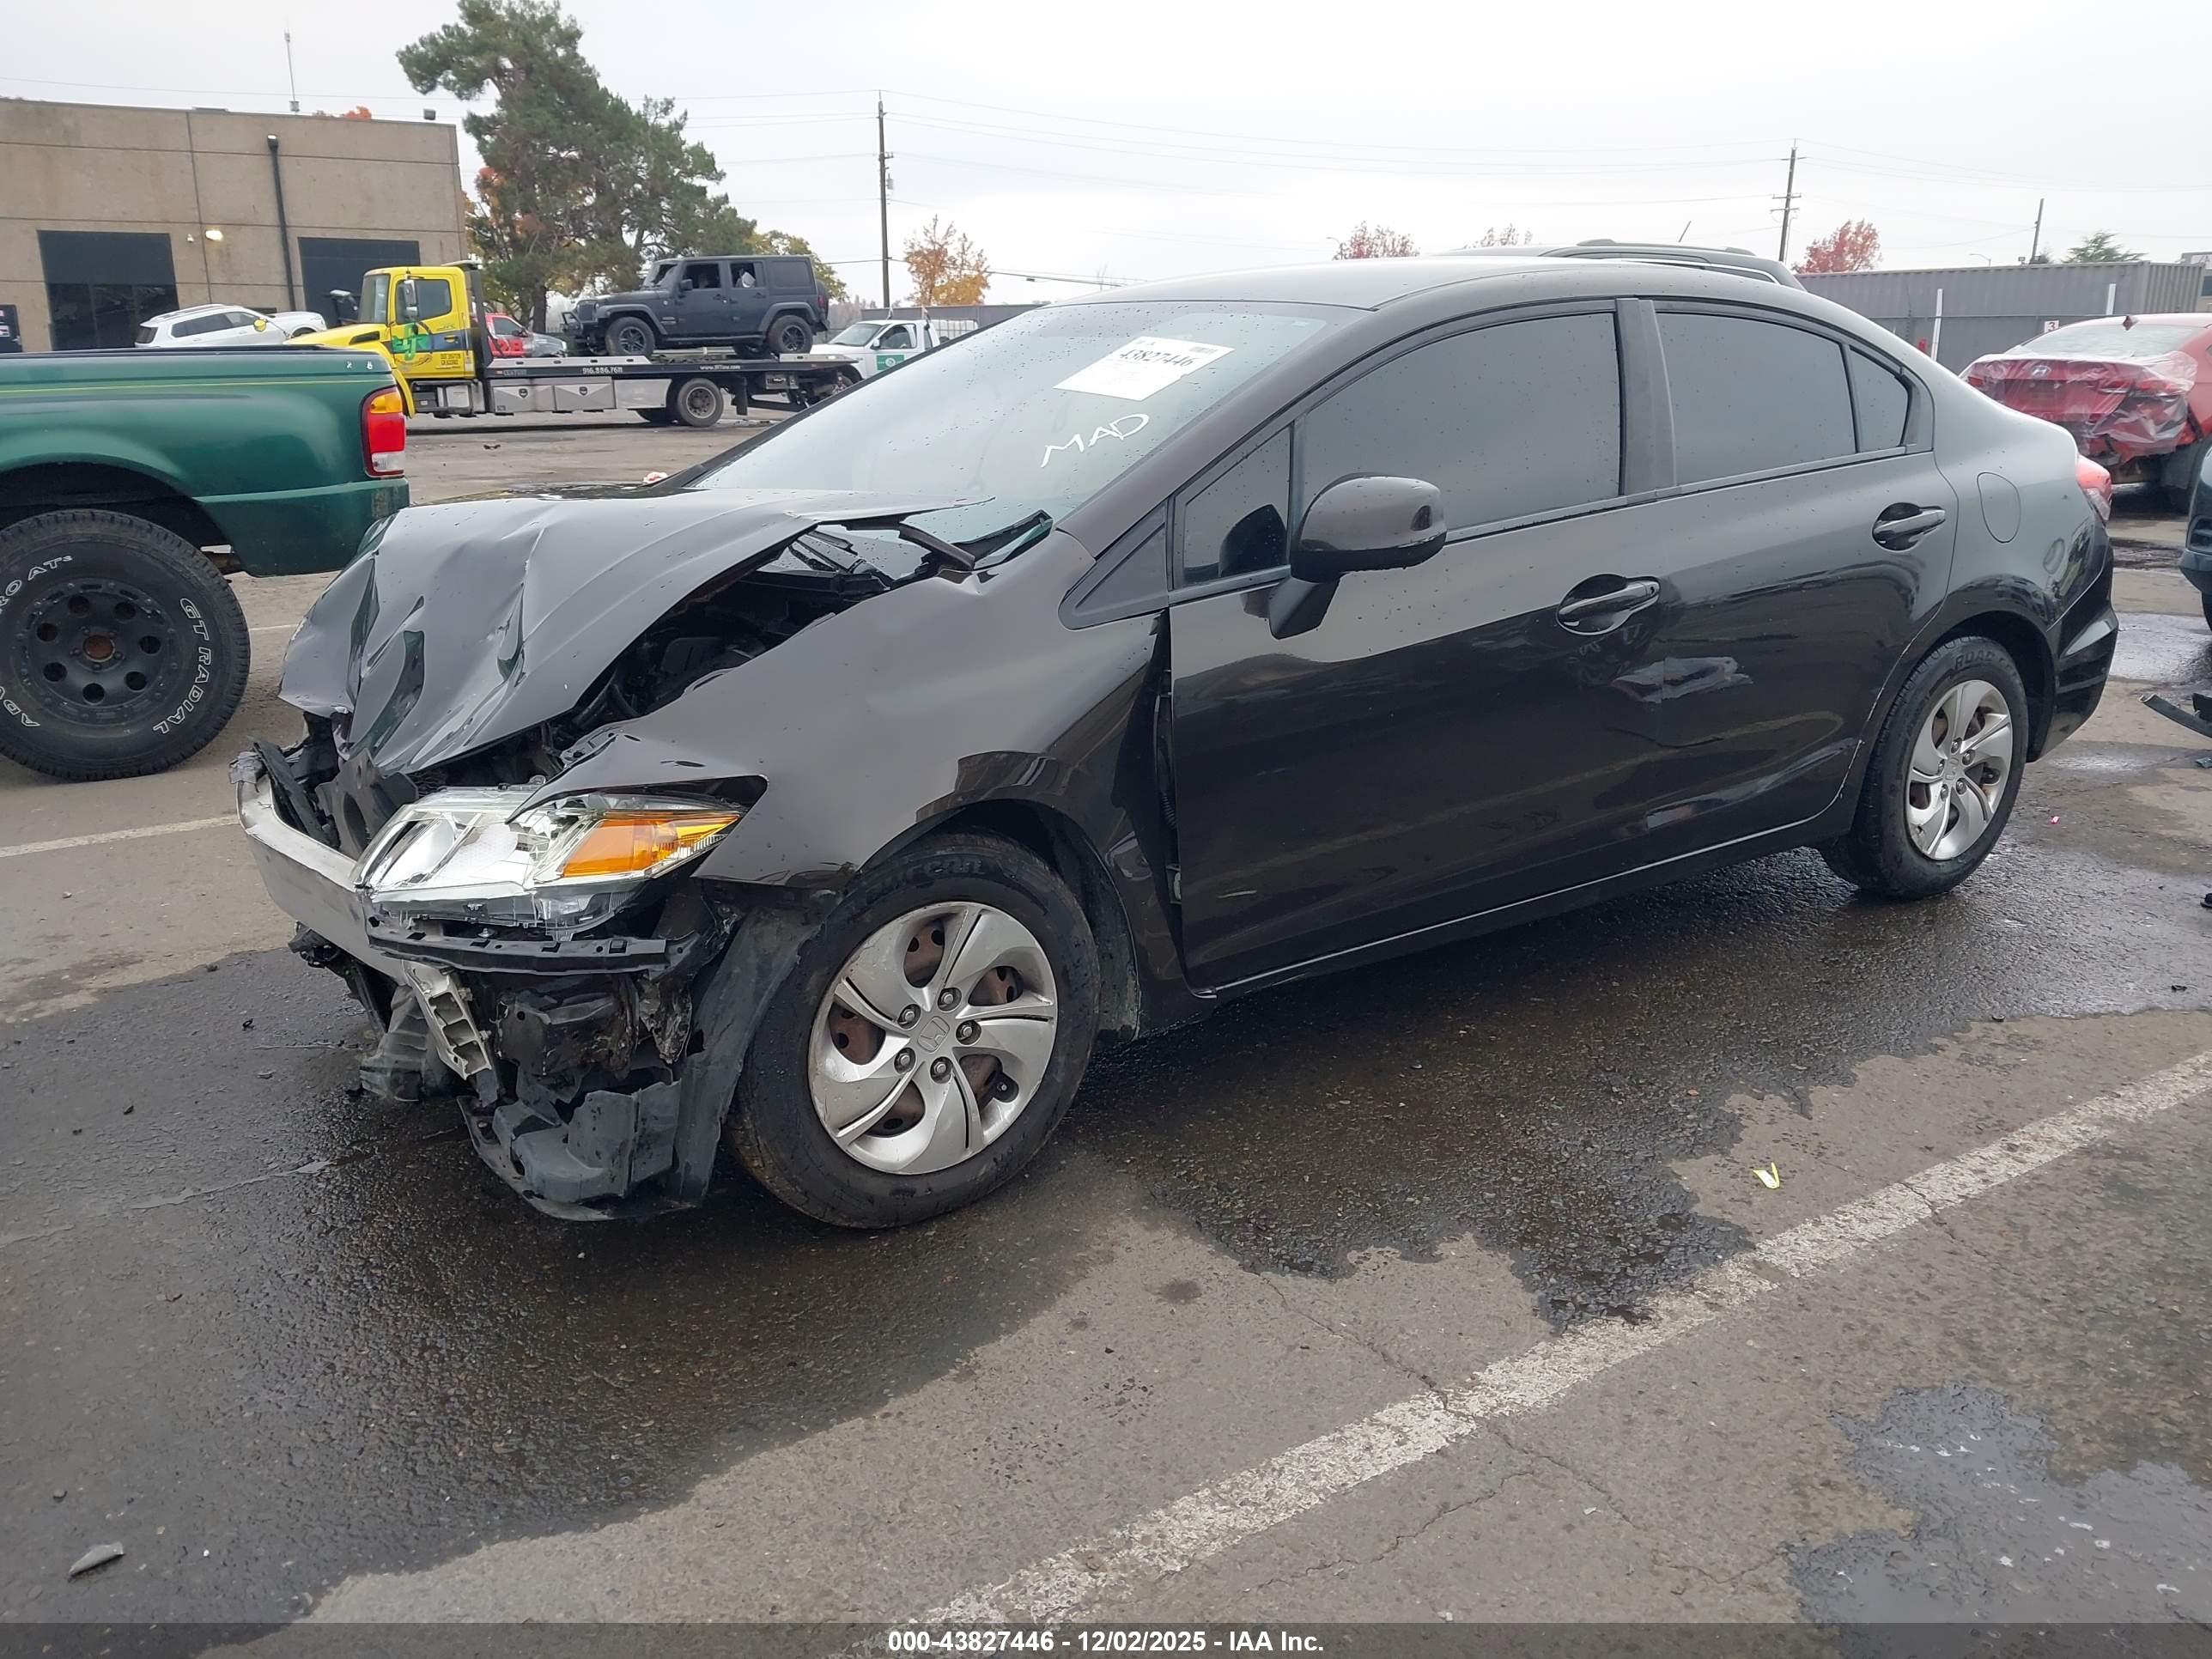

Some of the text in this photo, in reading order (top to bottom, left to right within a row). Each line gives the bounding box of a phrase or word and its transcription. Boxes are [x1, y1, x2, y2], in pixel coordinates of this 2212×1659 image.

[1119, 348, 1195, 368] 43827446
[1040, 413, 1150, 468] MAD
[152, 598, 211, 734] GT RADIAL
